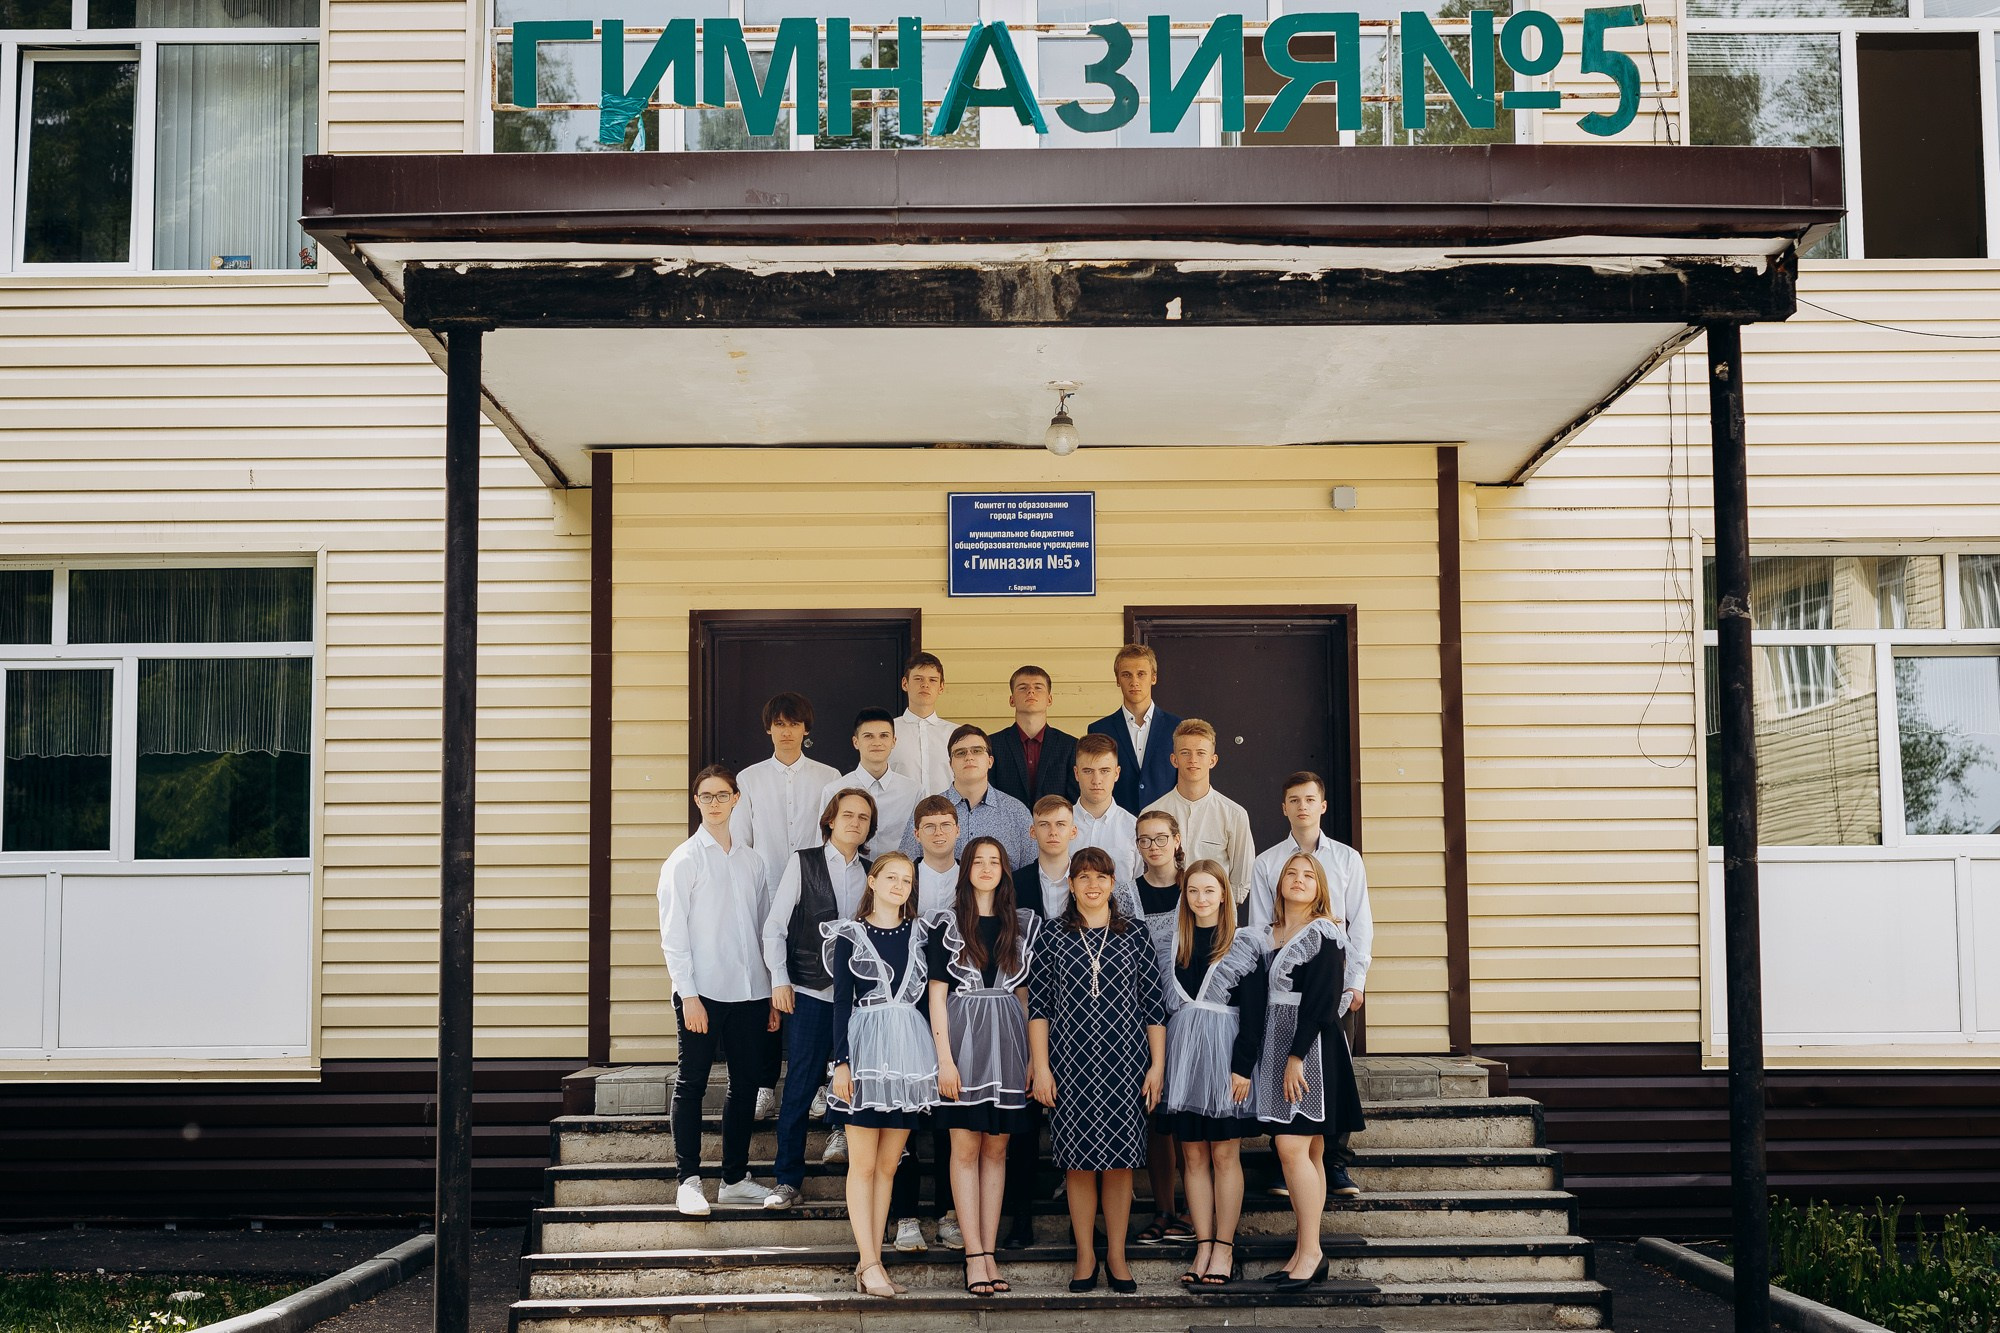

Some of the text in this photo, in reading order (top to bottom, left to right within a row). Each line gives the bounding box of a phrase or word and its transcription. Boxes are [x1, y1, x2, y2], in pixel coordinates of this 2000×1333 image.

[512, 14, 1362, 147] ГИМНАЗИЯ
[974, 501, 1005, 510] Комитет
[1018, 501, 1069, 510] образованию
[989, 511, 1054, 521] города Барнаула
[969, 530, 1075, 539] муниципальное бюджетное
[954, 541, 1090, 550] общеобразовательное учреждение
[964, 555, 1043, 570] «Гимназия
